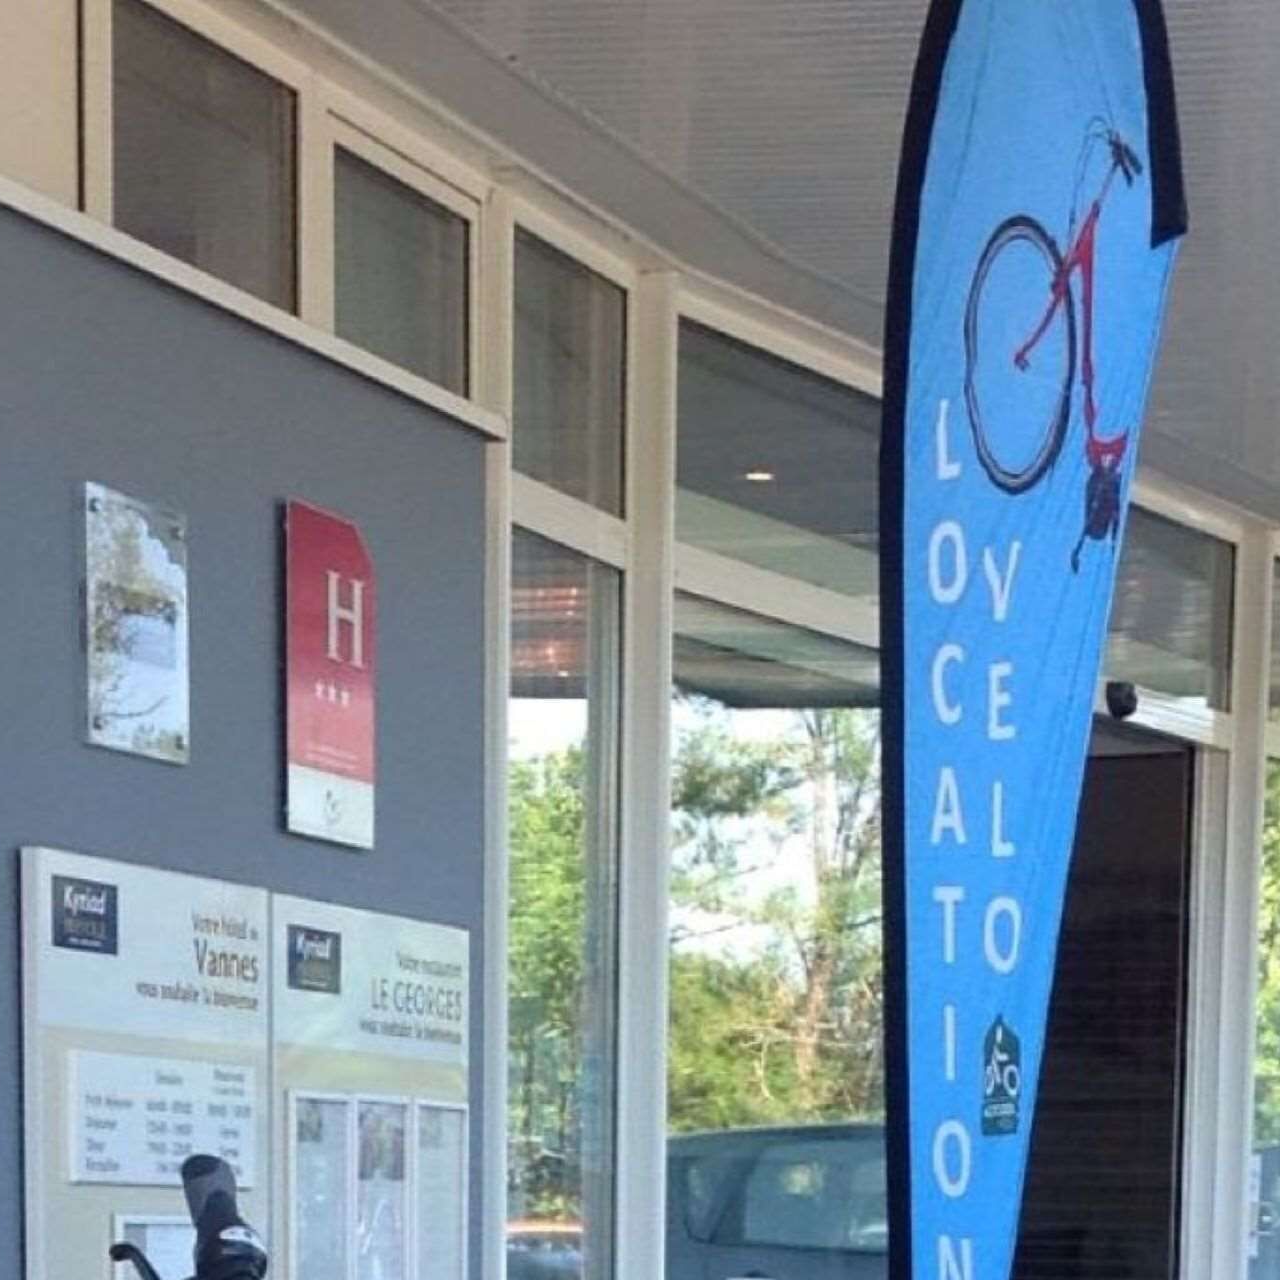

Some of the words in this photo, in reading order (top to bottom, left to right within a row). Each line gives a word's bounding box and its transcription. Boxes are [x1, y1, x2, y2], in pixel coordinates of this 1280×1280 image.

[326, 569, 365, 669] H
[983, 541, 1021, 975] VELO
[194, 937, 259, 983] Vannes
